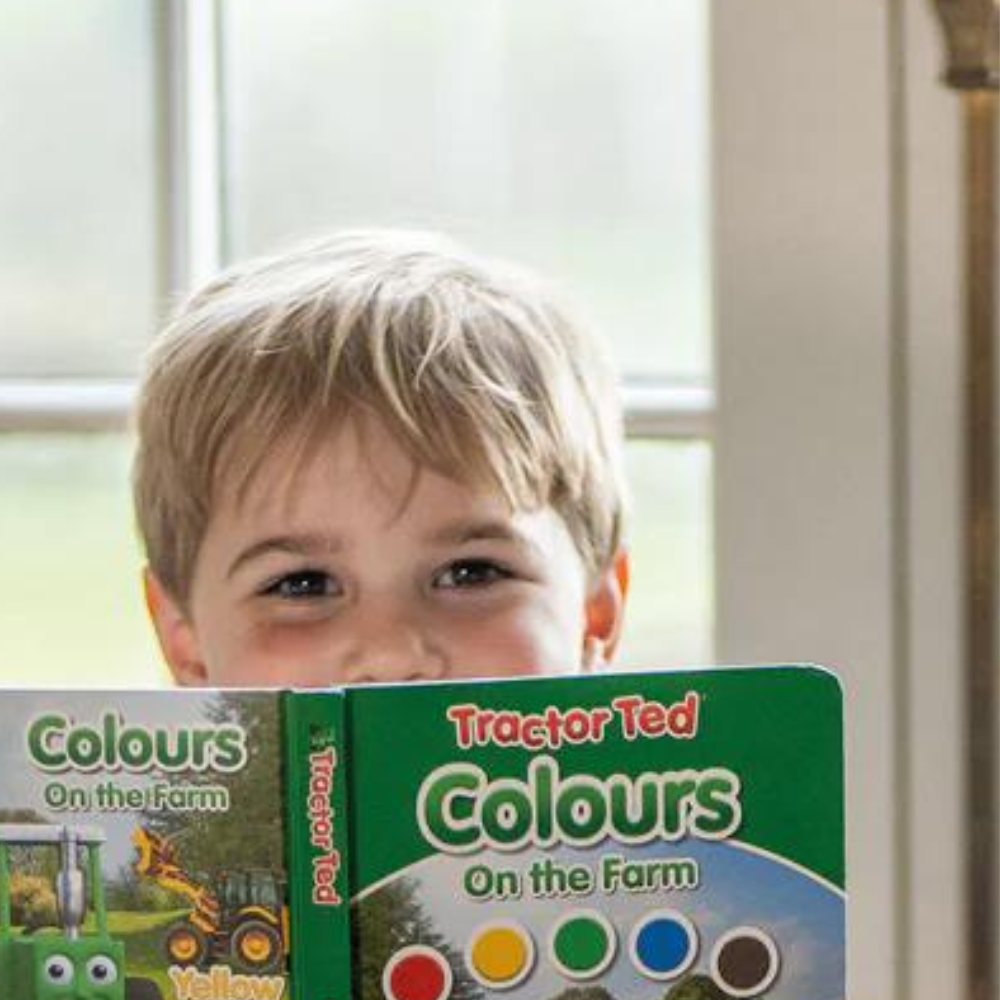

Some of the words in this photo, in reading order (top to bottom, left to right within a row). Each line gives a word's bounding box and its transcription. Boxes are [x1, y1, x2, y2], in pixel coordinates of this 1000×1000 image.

[27, 712, 246, 775] Colours
[447, 702, 612, 751] Tractor
[613, 692, 700, 741] Ted
[44, 783, 86, 812] On
[92, 782, 143, 812] the
[151, 783, 228, 812] Farm
[308, 746, 336, 850] Tractor
[417, 755, 742, 854] Colours
[311, 849, 341, 905] Ted
[463, 865, 521, 900] On
[530, 859, 593, 895] the
[602, 857, 699, 892] Farm
